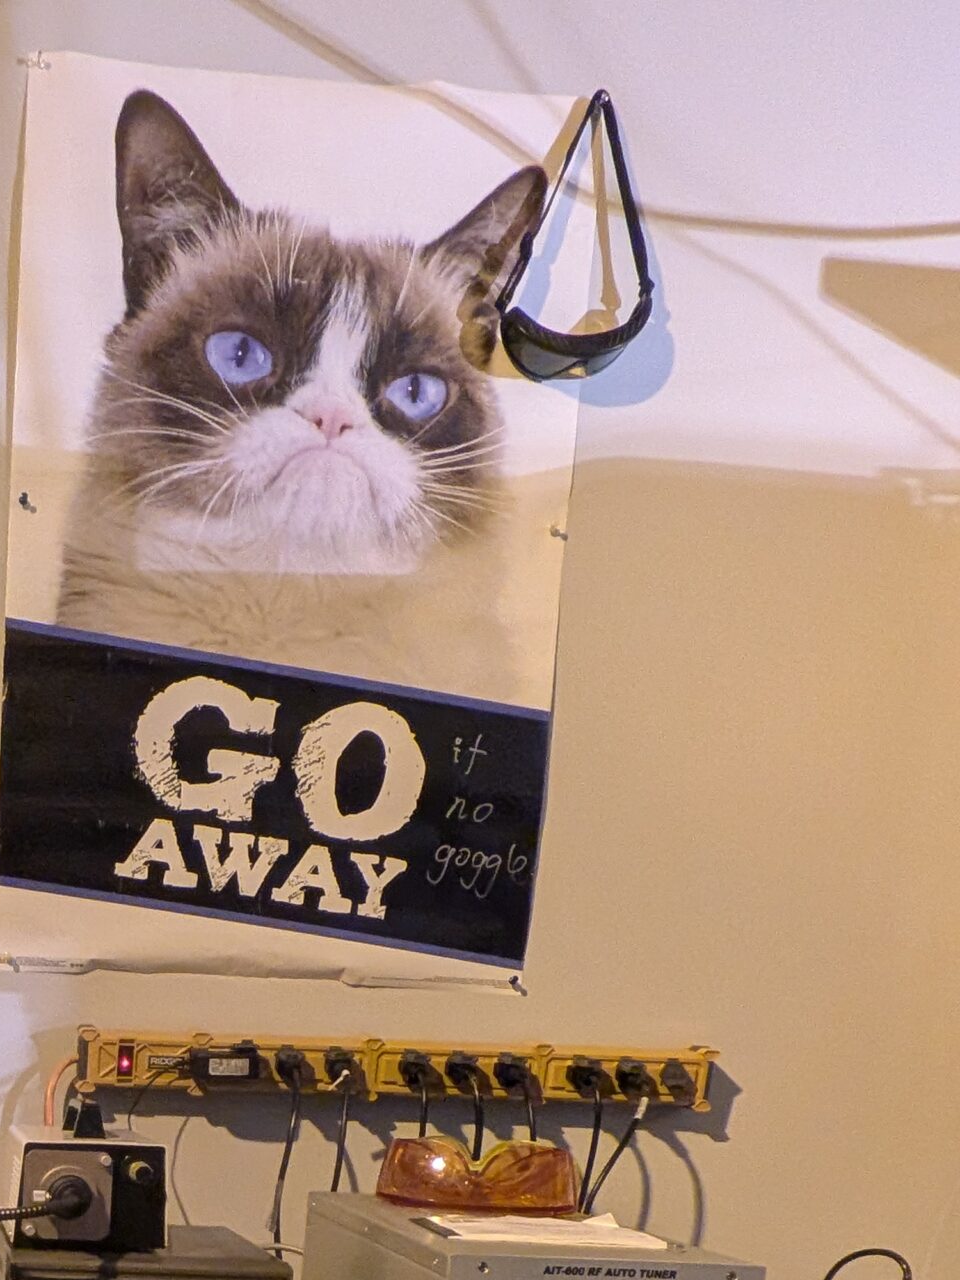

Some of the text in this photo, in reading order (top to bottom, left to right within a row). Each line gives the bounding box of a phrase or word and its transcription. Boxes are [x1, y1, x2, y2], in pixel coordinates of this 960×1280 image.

[133, 675, 426, 842] GO
[445, 796, 494, 823] no
[114, 818, 407, 920] AWAY
[587, 1267, 602, 1276] RF
[605, 1268, 637, 1278] AUTO
[640, 1269, 677, 1279] TUNER
